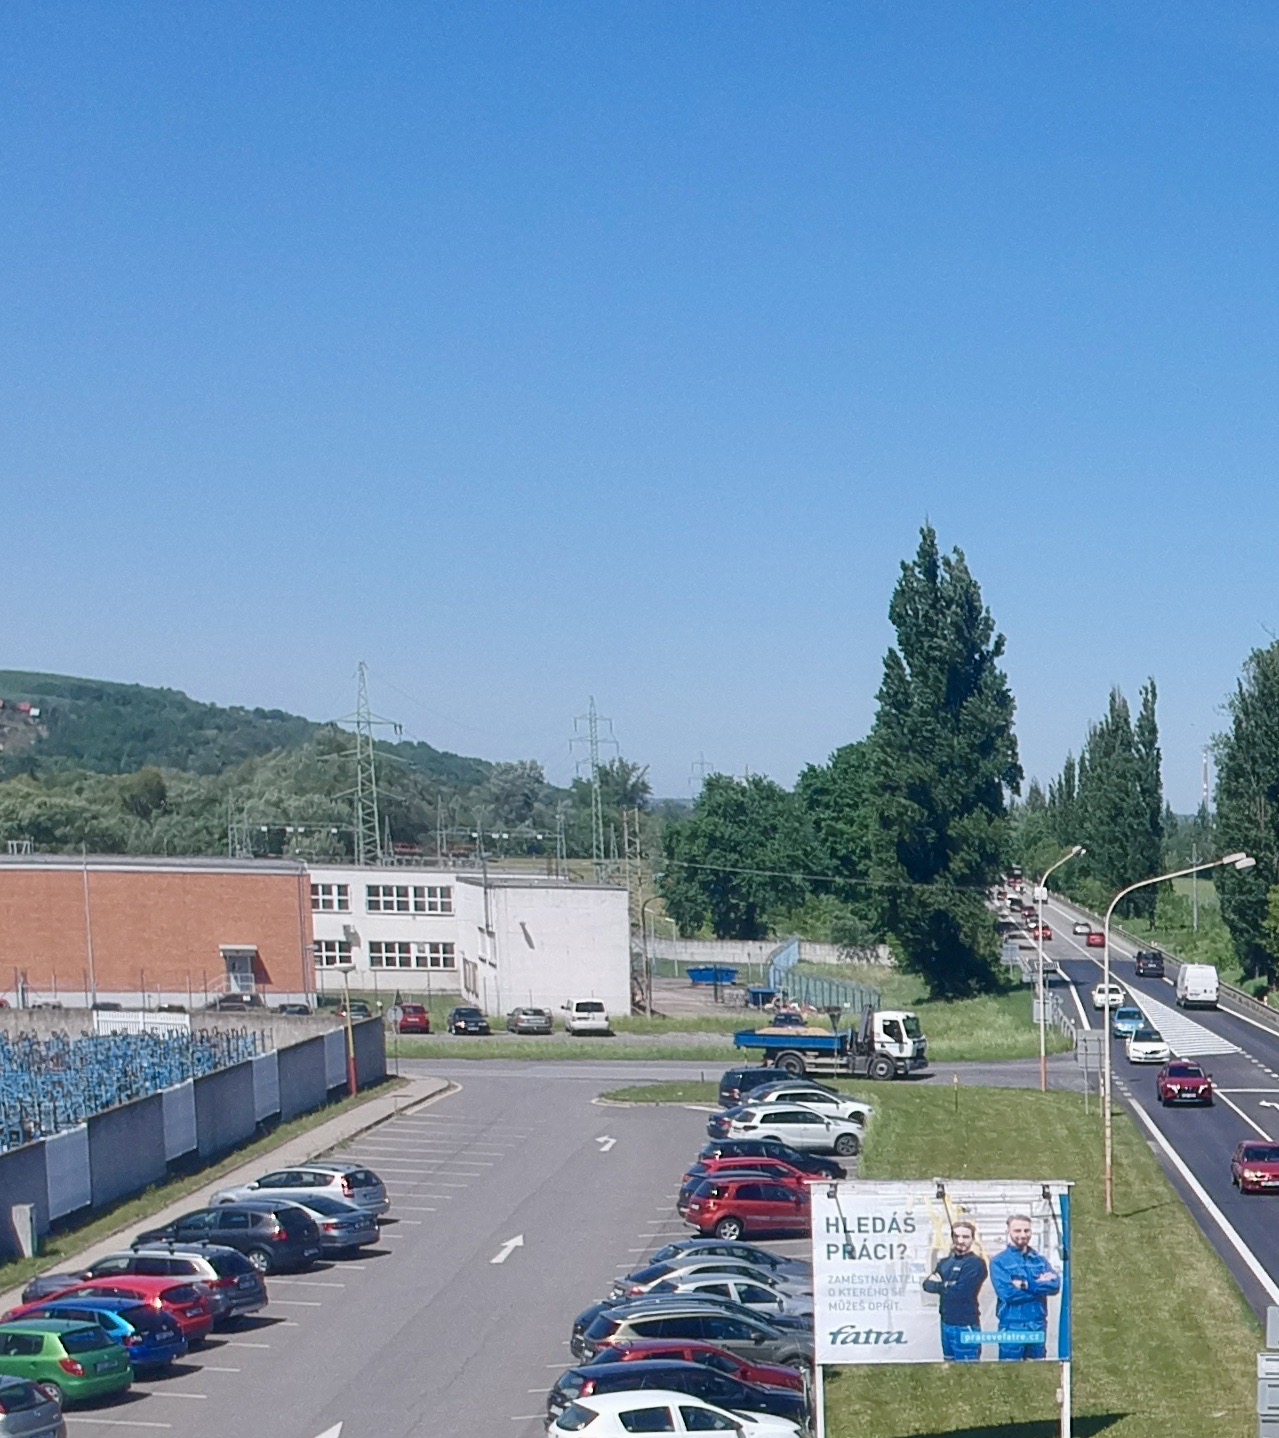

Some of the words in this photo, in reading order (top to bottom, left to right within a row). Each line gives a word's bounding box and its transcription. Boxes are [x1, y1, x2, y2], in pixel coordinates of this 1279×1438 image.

[825, 1211, 916, 1234] HLEDÁŠ
[826, 1238, 907, 1260] PRÁCI?
[838, 1286, 889, 1297] KTERÉHO
[828, 1298, 866, 1311] MŮŽEŠ
[829, 1325, 908, 1346] fatra
[964, 1332, 1040, 1343] pracevefatre.cz
